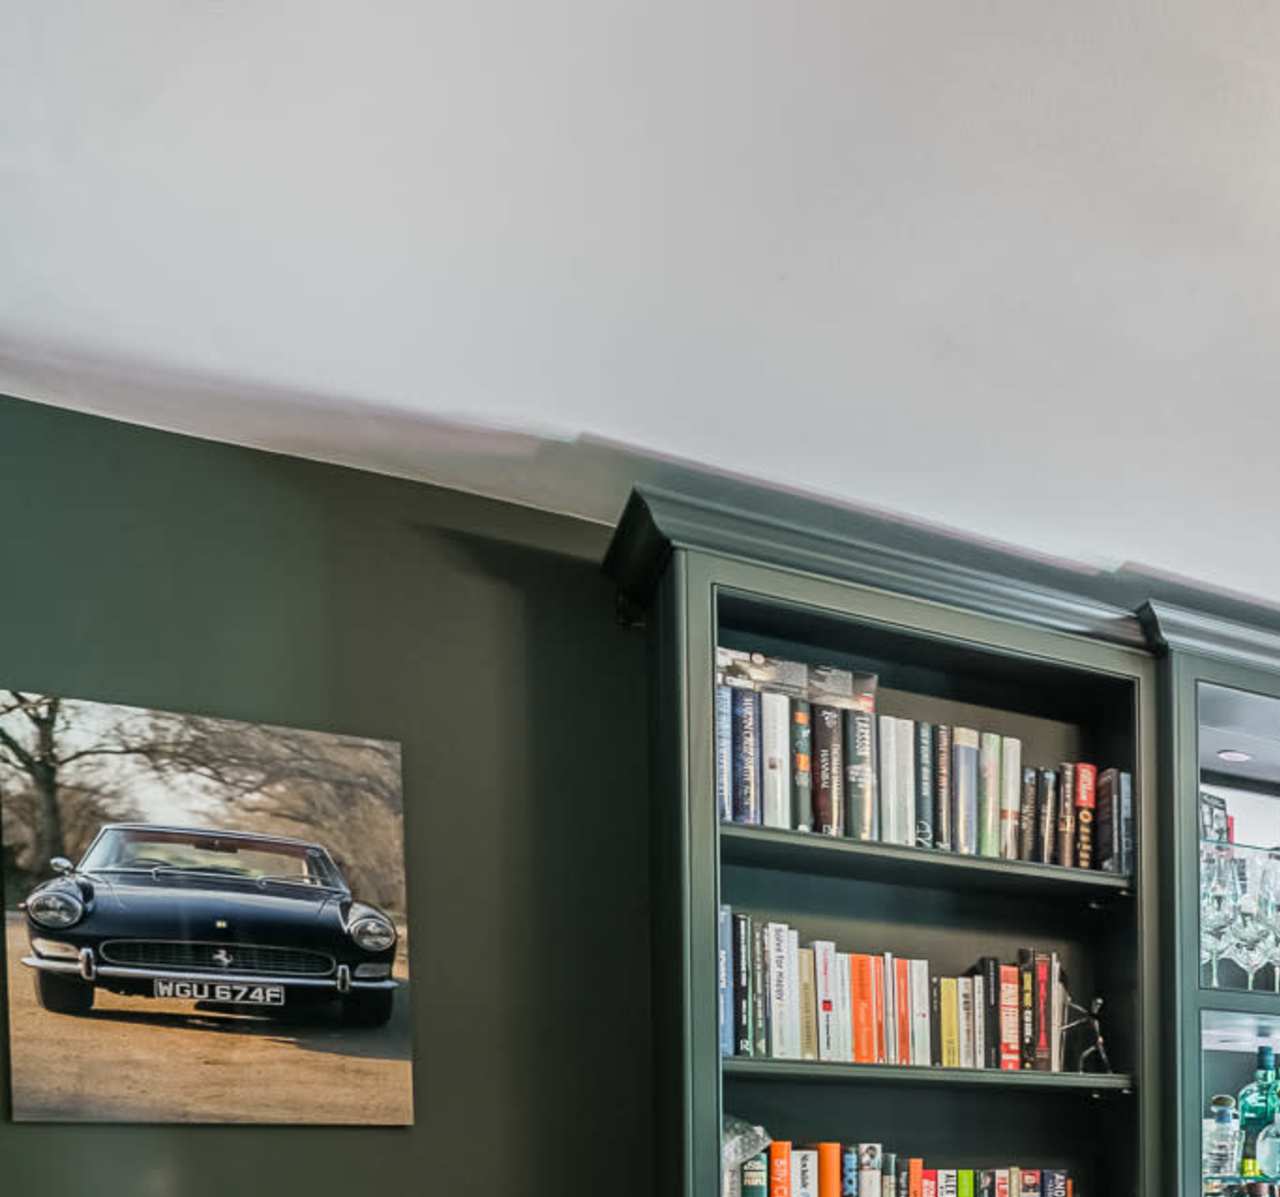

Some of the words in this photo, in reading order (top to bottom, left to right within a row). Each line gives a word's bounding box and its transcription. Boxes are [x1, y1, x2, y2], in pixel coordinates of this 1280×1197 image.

[855, 717, 871, 756] LARSSON
[820, 749, 829, 789] HANNIBAL
[774, 928, 783, 952] Solve
[776, 955, 784, 969] for
[157, 980, 209, 1000] WGU
[217, 984, 282, 1004] 674F
[775, 971, 785, 1001] Happy
[772, 1158, 786, 1183] Billy
[945, 1174, 956, 1195] ALEX
